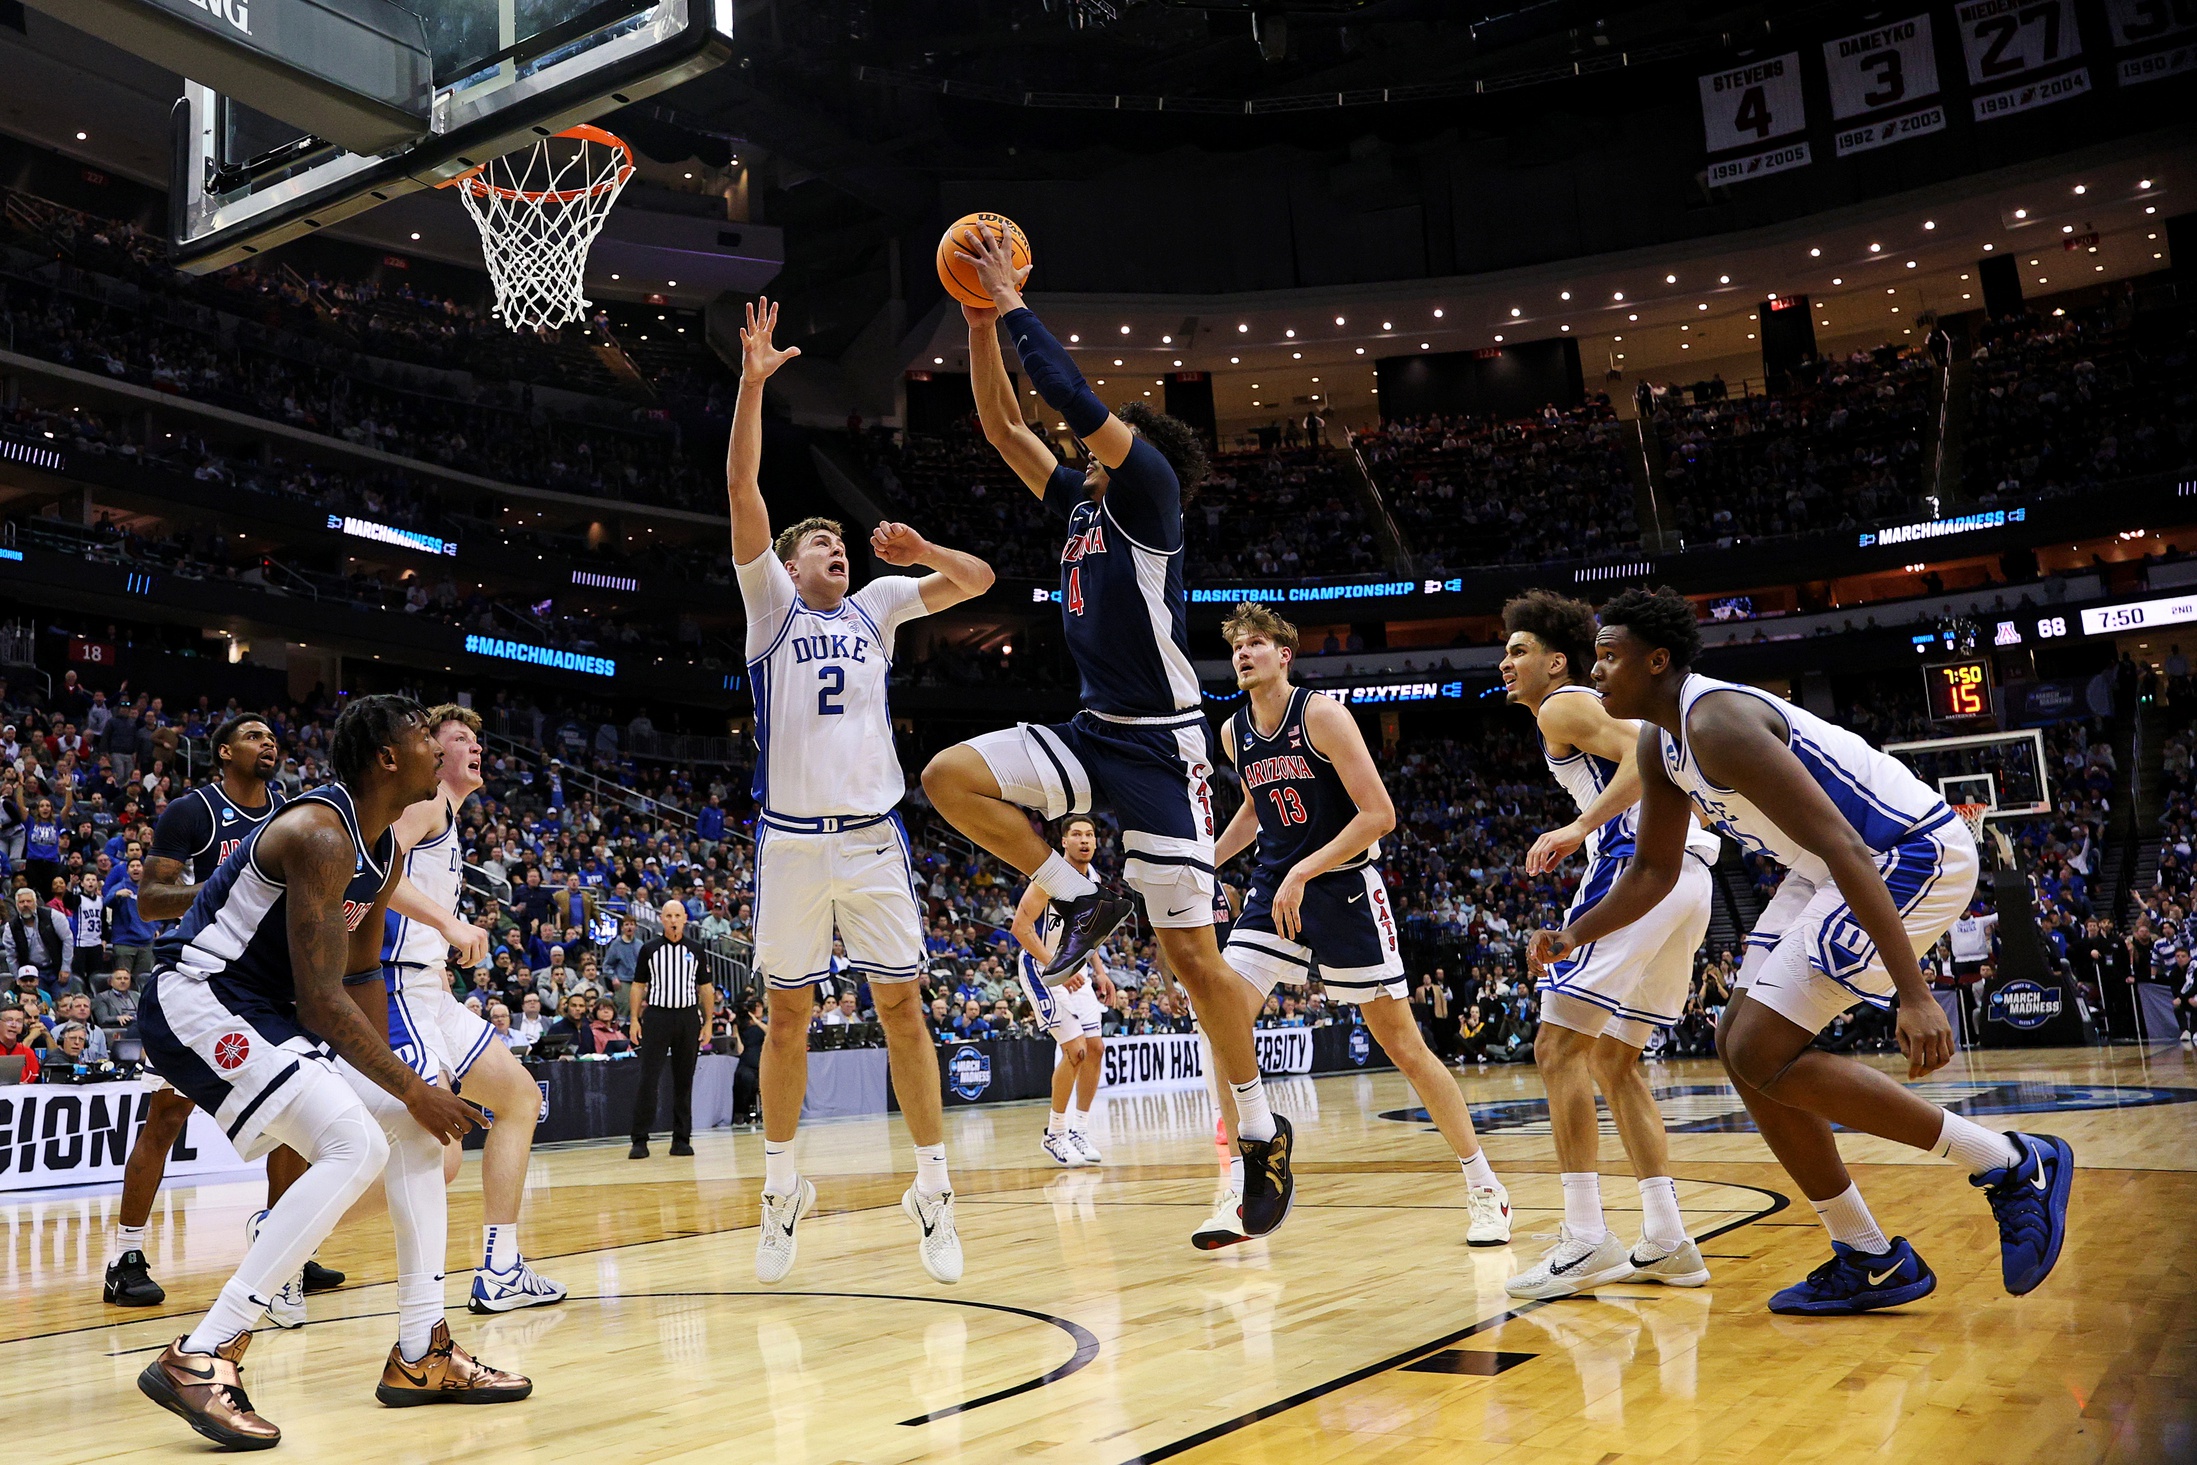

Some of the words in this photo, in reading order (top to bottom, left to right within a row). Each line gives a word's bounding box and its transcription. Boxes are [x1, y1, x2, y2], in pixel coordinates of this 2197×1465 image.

[1839, 22, 1915, 58] DANEYKO
[1975, 2, 2060, 77] 27
[1713, 60, 1784, 92] STEVENS
[1861, 49, 1905, 107] 3
[2124, 57, 2166, 78] 1990
[1735, 85, 1772, 138] 4
[1981, 95, 2015, 115] 1991
[2040, 74, 2084, 99] 2004
[1838, 129, 1874, 149] 1982
[1901, 110, 1942, 132] 2003
[1713, 164, 1743, 180] 1991
[1766, 147, 1805, 168] 2005
[1778, 296, 1796, 310] 121
[344, 516, 443, 555] MARCHMADNESS
[1878, 509, 2005, 547] MARCHMADNESS
[1068, 566, 1085, 616] 4
[1191, 588, 1285, 603] BASKETBALL
[1289, 581, 1415, 602] CHAMPIONSHIP
[2037, 616, 2067, 639] 68
[2098, 607, 2144, 628] 7:50
[82, 644, 102, 662] 18
[465, 633, 616, 678] #MARCHMADNESS
[791, 634, 869, 664] DUKE
[818, 665, 845, 716] 2
[1943, 665, 1983, 685] 7:50
[1351, 682, 1438, 704] SIXTEEN
[1951, 683, 1981, 713] 15
[1244, 755, 1315, 790] ARIZONA
[1191, 763, 1214, 837] CATS
[1269, 786, 1308, 828] 13
[83, 908, 101, 919] DUK
[1373, 888, 1396, 952] CATS
[2003, 991, 2041, 1005] MARCH
[2009, 1000, 2060, 1014] MADNESS
[1105, 1041, 1165, 1086] SETON
[1170, 1037, 1203, 1080] HAL
[1256, 1032, 1307, 1072] ERSITY
